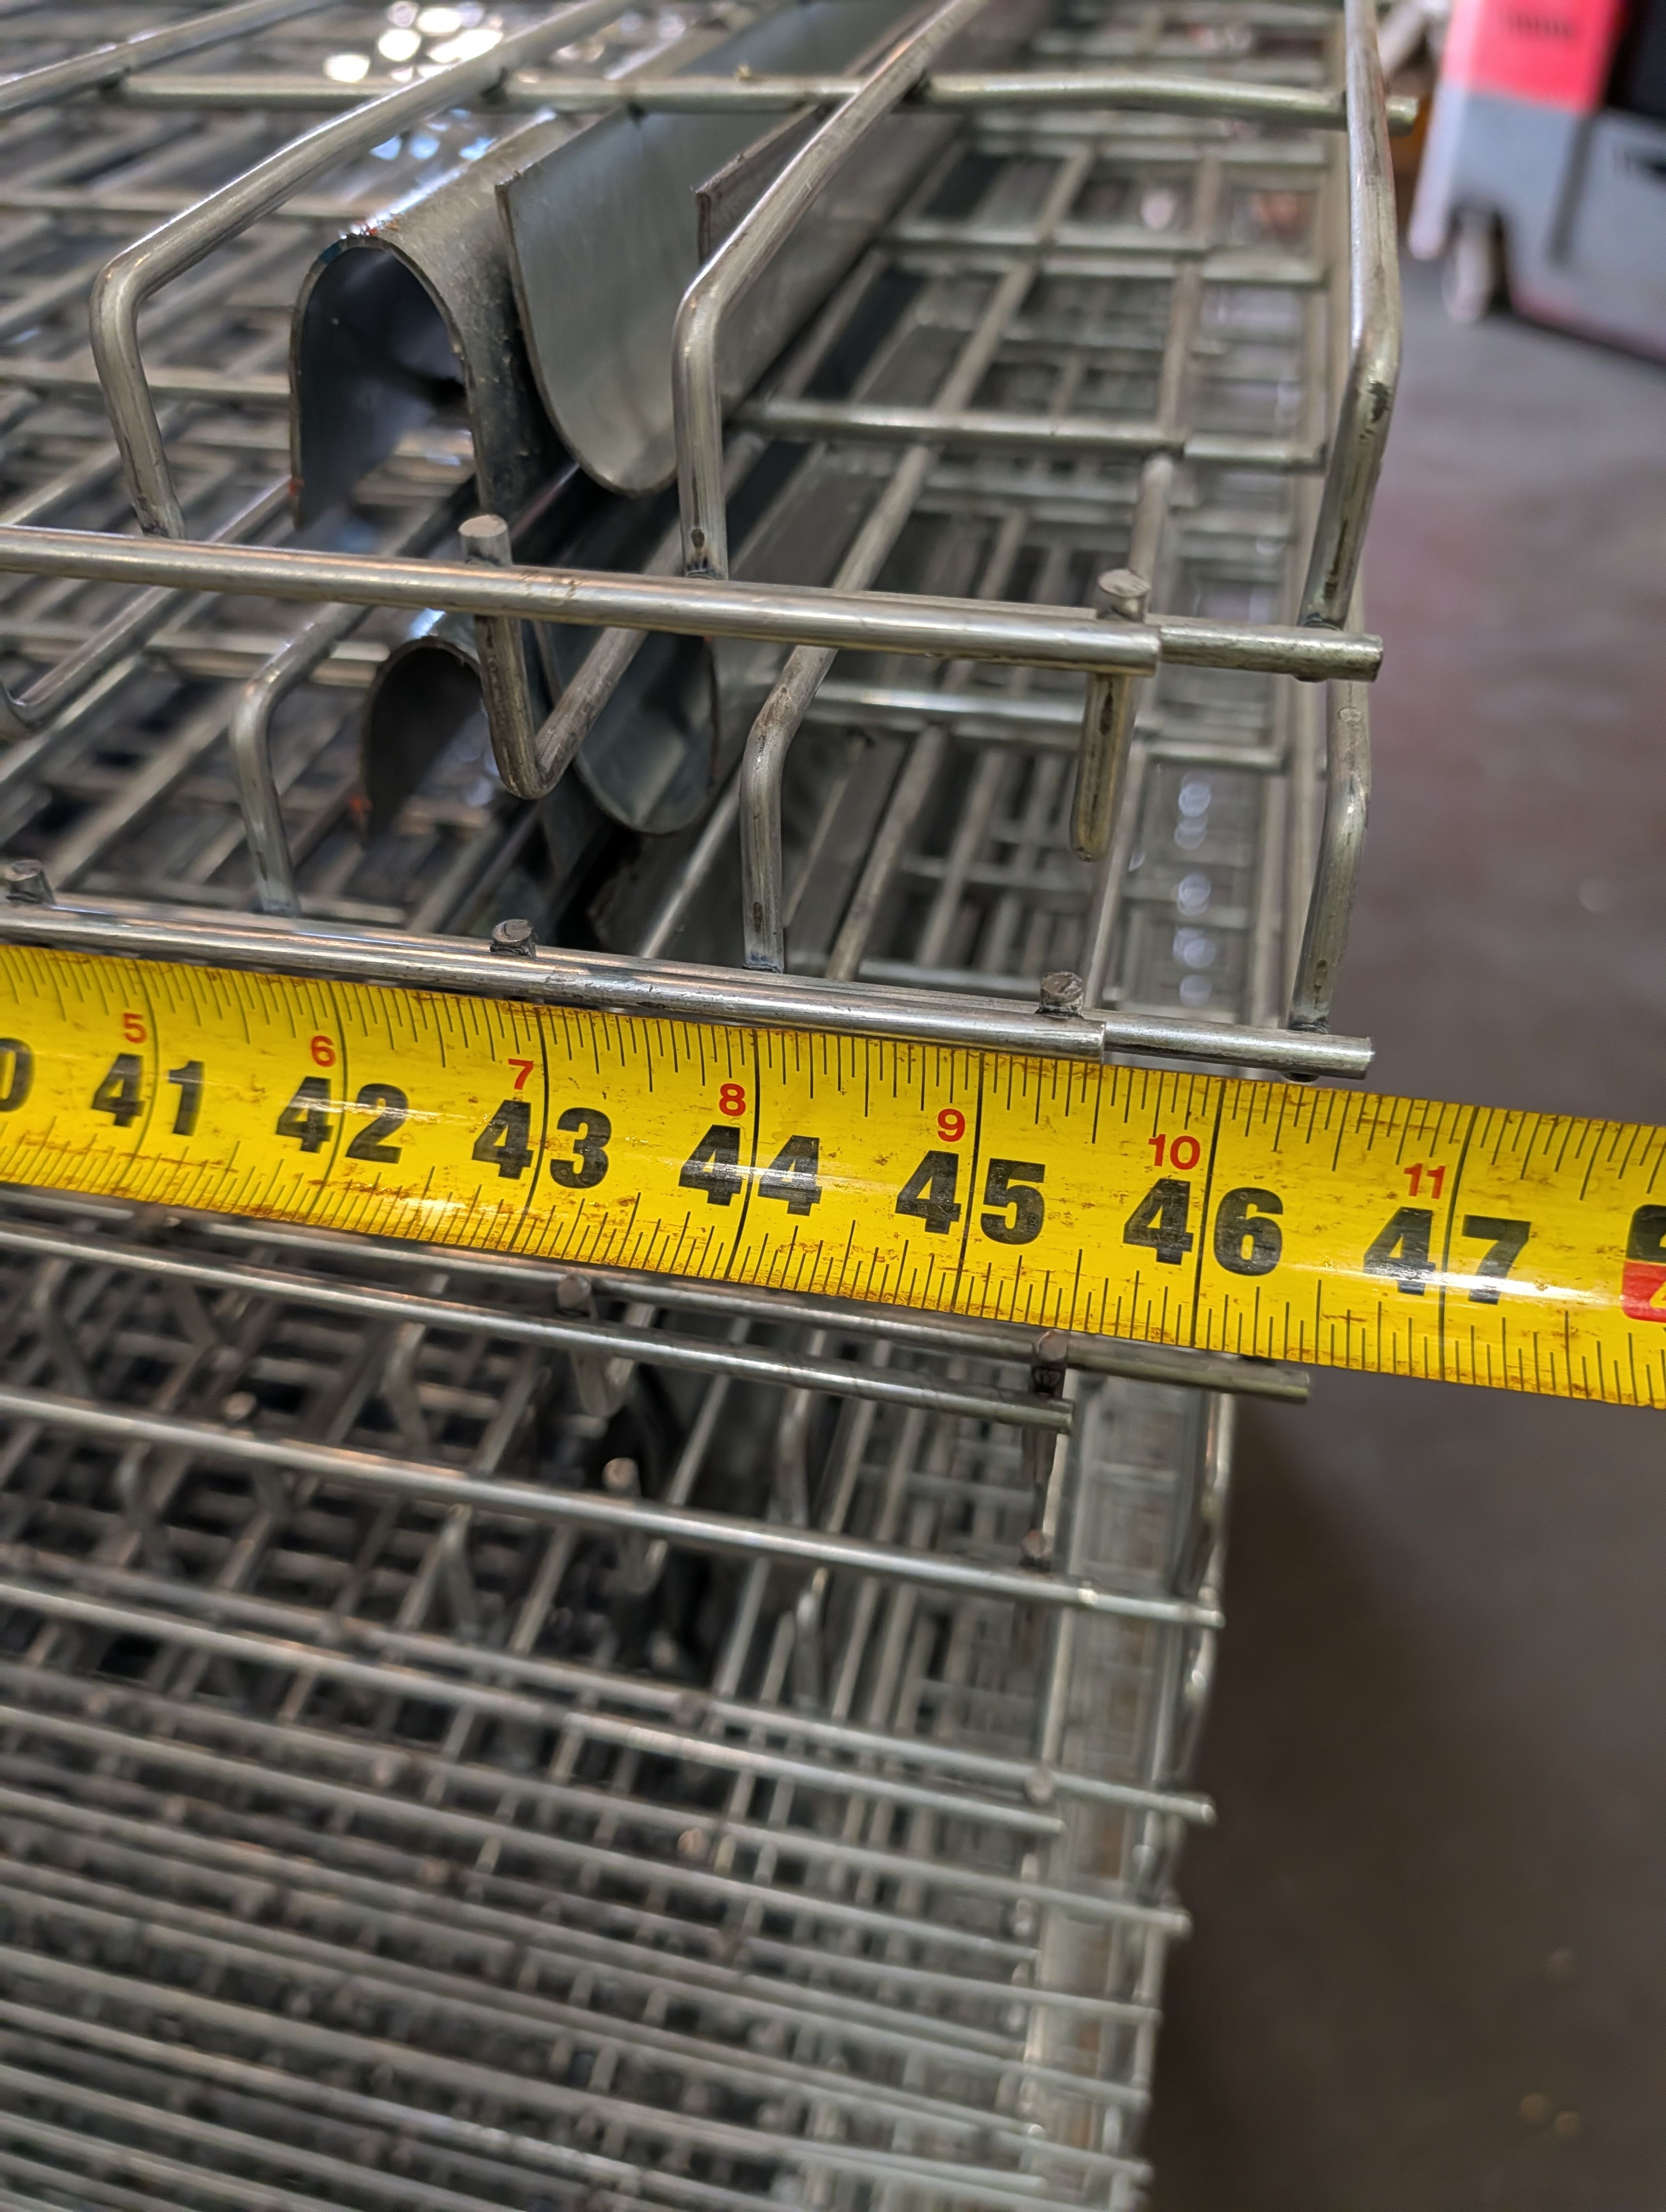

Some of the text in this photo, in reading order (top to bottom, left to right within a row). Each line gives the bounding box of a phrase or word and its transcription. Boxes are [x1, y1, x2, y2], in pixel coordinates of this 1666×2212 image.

[91, 1053, 205, 1136] 41
[275, 1076, 410, 1164] 42
[472, 1099, 612, 1189] 43
[678, 1124, 823, 1216] 44
[895, 1150, 1046, 1245] 45
[1122, 1178, 1284, 1276] 46
[1363, 1207, 1532, 1305] 47
[123, 1013, 1446, 1199] 5 6 7 8 9 10 11
